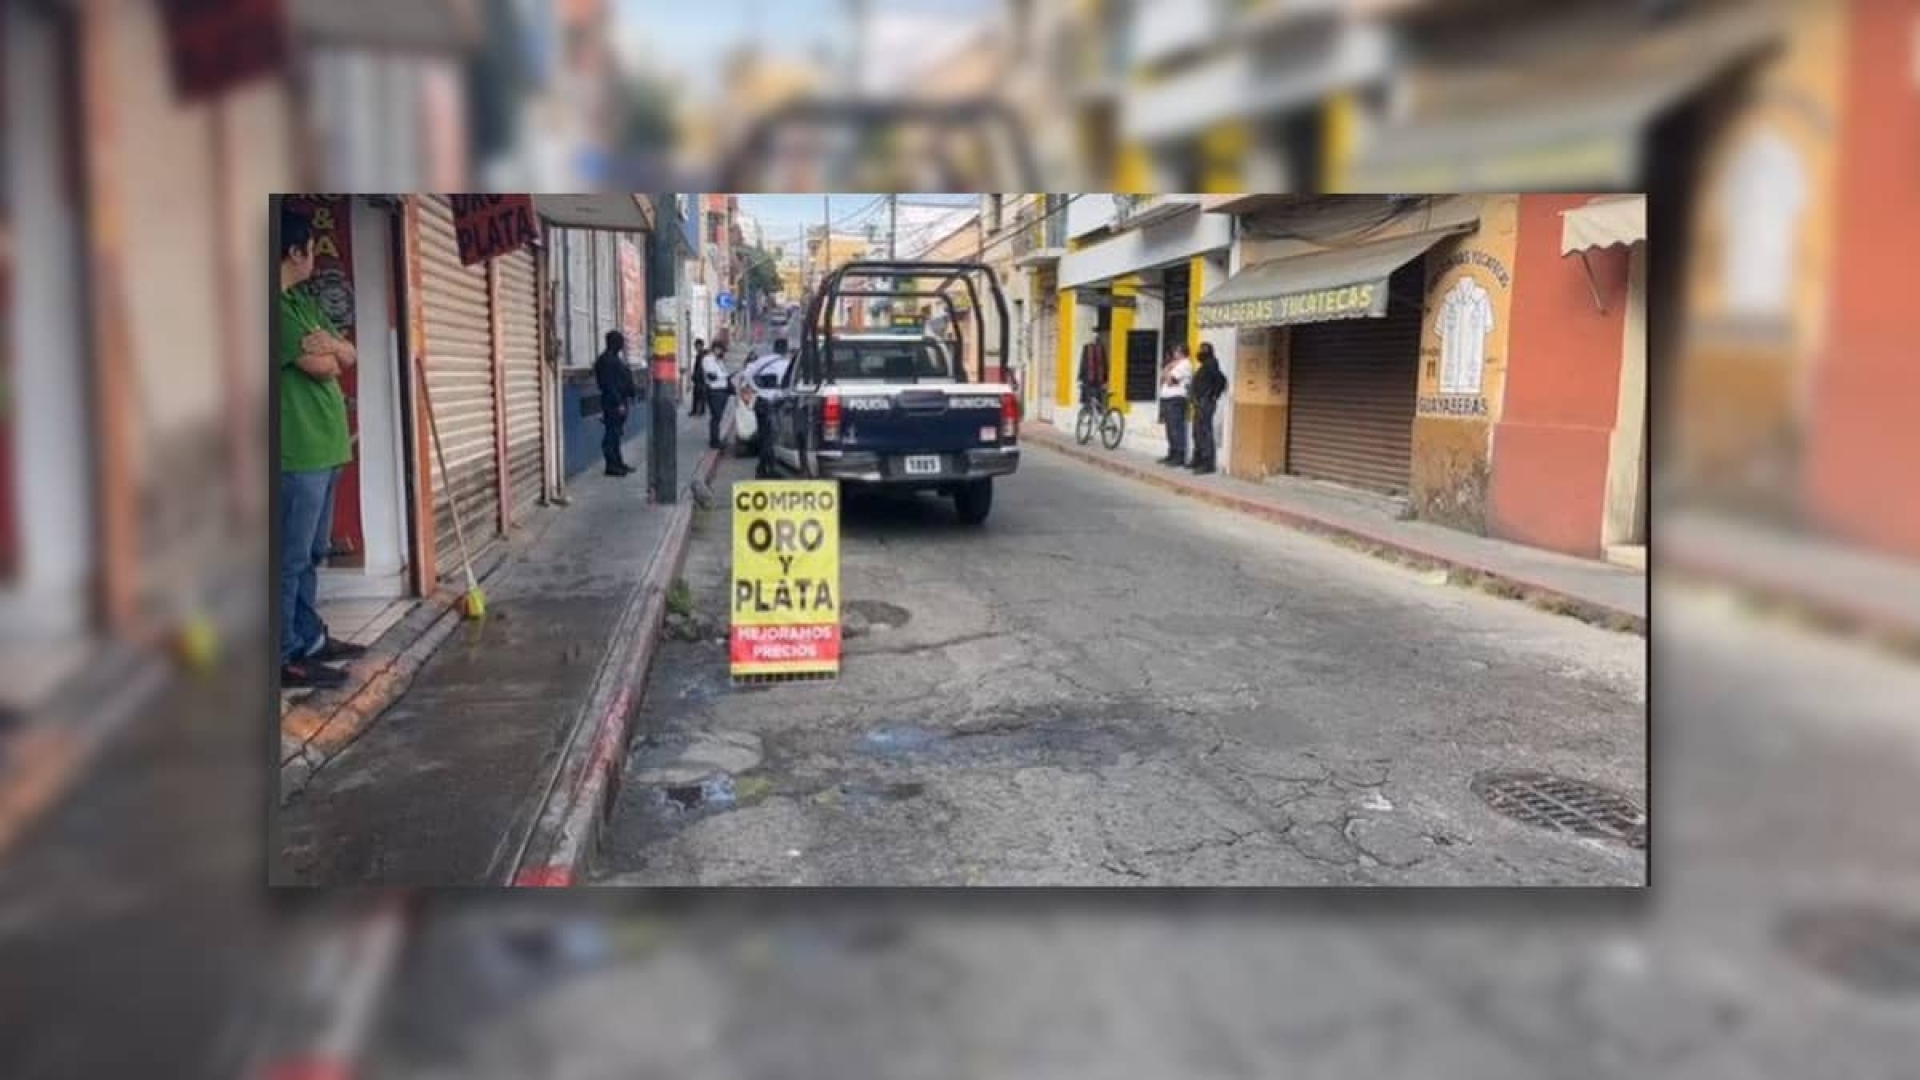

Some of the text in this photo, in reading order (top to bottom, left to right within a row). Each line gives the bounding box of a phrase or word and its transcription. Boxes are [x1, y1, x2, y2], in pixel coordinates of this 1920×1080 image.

[1280, 284, 1373, 317] YUCATECAS
[736, 491, 834, 512] COMPRO
[747, 519, 824, 552] ORO
[778, 554, 793, 576] Y
[736, 578, 834, 612] PLATA
[737, 625, 833, 641] MEJORAMOS
[752, 643, 818, 660] PRECIOS
